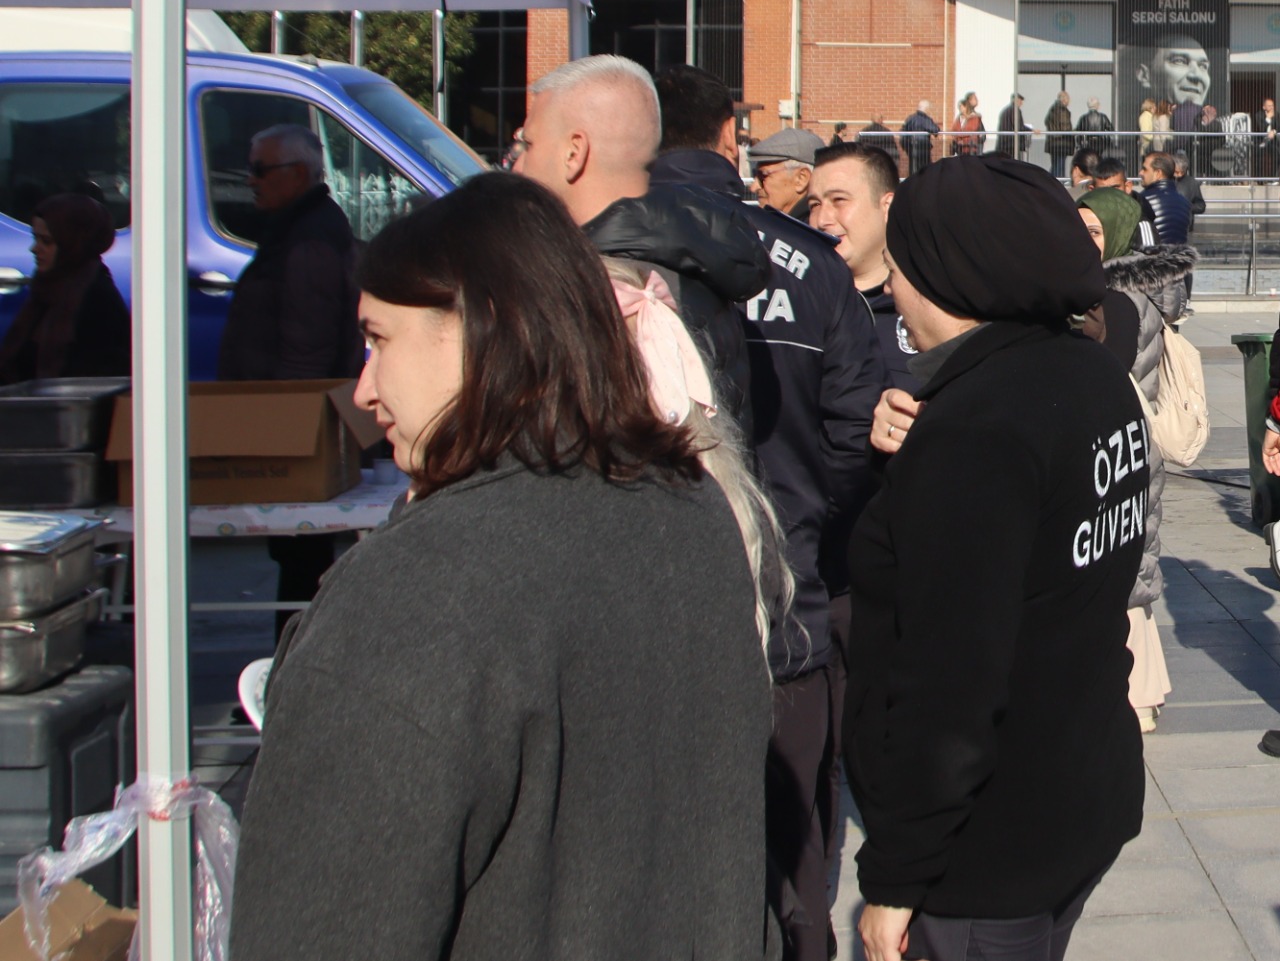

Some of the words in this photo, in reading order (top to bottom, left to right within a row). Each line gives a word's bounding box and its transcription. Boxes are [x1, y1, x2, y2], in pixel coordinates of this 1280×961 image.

[1132, 10, 1167, 24] SERGİ
[1169, 11, 1216, 24] SALONU
[756, 230, 811, 281] ER
[746, 288, 796, 322] TA
